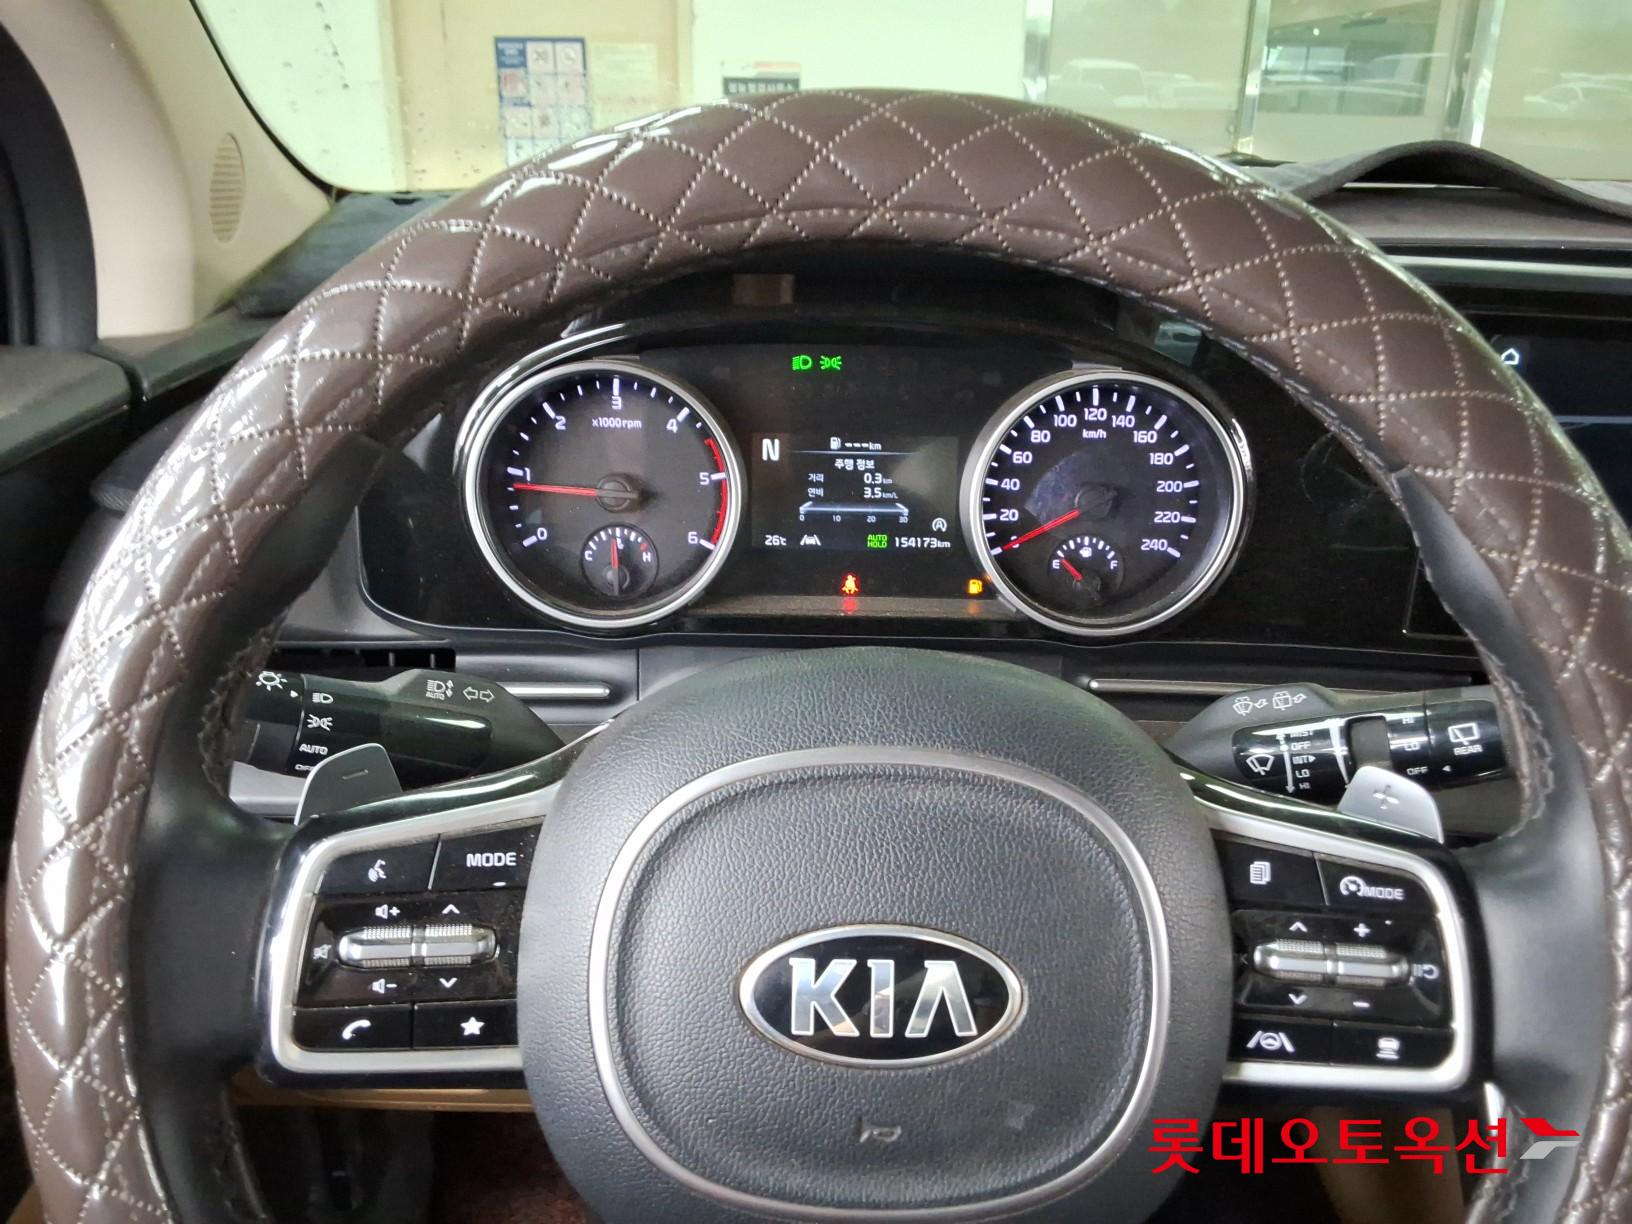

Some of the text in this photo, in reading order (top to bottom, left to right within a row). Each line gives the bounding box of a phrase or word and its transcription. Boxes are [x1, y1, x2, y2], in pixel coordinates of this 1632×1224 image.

[611, 397, 622, 409] 3
[1084, 408, 1107, 420] 120
[555, 416, 566, 430] 2
[1053, 415, 1077, 427] 100
[1112, 415, 1135, 428] 140
[666, 422, 678, 433] 4
[1030, 431, 1050, 443] 80
[1082, 429, 1107, 439] km/h
[1133, 431, 1157, 443] 160
[762, 438, 780, 461] N
[1013, 452, 1033, 464] 60
[1150, 452, 1173, 465] 180
[523, 468, 531, 485] 1
[699, 473, 709, 485] 5
[1001, 479, 1020, 490] 40
[1156, 481, 1182, 492] 200
[1000, 509, 1019, 521] 20
[1154, 512, 1180, 523] 220
[537, 528, 547, 540] 0
[688, 532, 698, 544] 6
[1141, 539, 1168, 551] 240
[585, 551, 592, 561] C
[643, 552, 651, 562] H
[1053, 560, 1060, 569] E
[1111, 560, 1118, 569] F
[299, 743, 328, 755] AUTO
[1295, 769, 1310, 778] LO
[466, 852, 517, 868] MODE
[1363, 886, 1405, 900] MODE
[789, 958, 978, 1038] KIA
